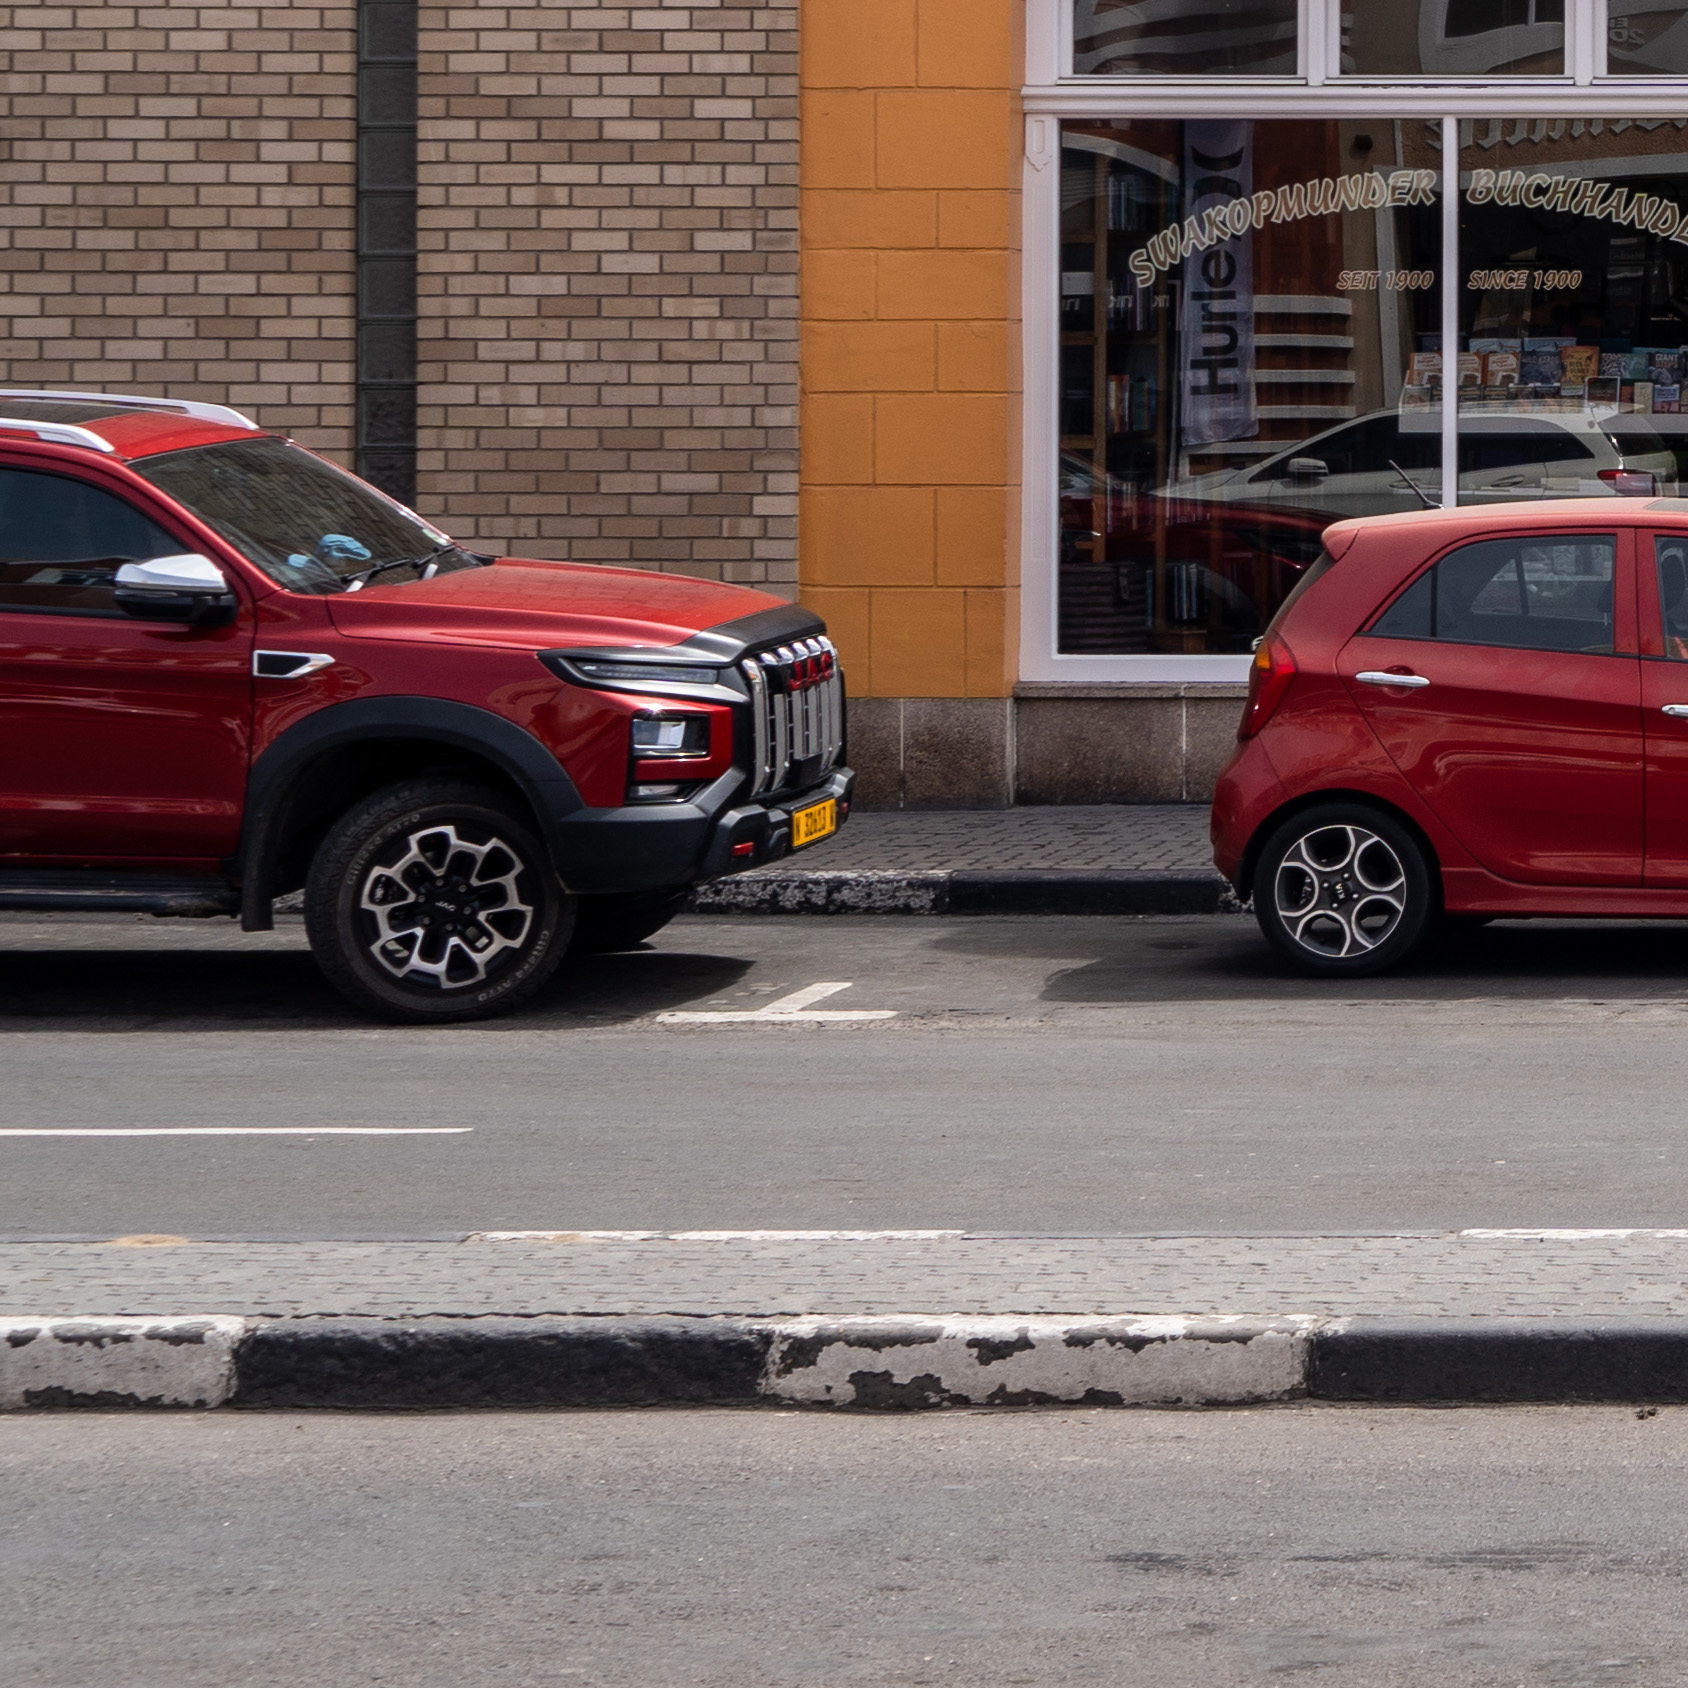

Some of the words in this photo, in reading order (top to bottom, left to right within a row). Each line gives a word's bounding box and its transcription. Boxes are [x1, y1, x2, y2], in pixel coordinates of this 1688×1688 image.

[1128, 165, 1440, 289] SWAKOPMUNDER
[1336, 269, 1381, 291] SEIT
[1384, 269, 1435, 292] 1900
[1467, 269, 1528, 291] SINCE
[1532, 269, 1583, 292] 1900
[1655, 353, 1679, 361] GIANT
[788, 649, 834, 691] JAC
[1334, 881, 1347, 901] KIA
